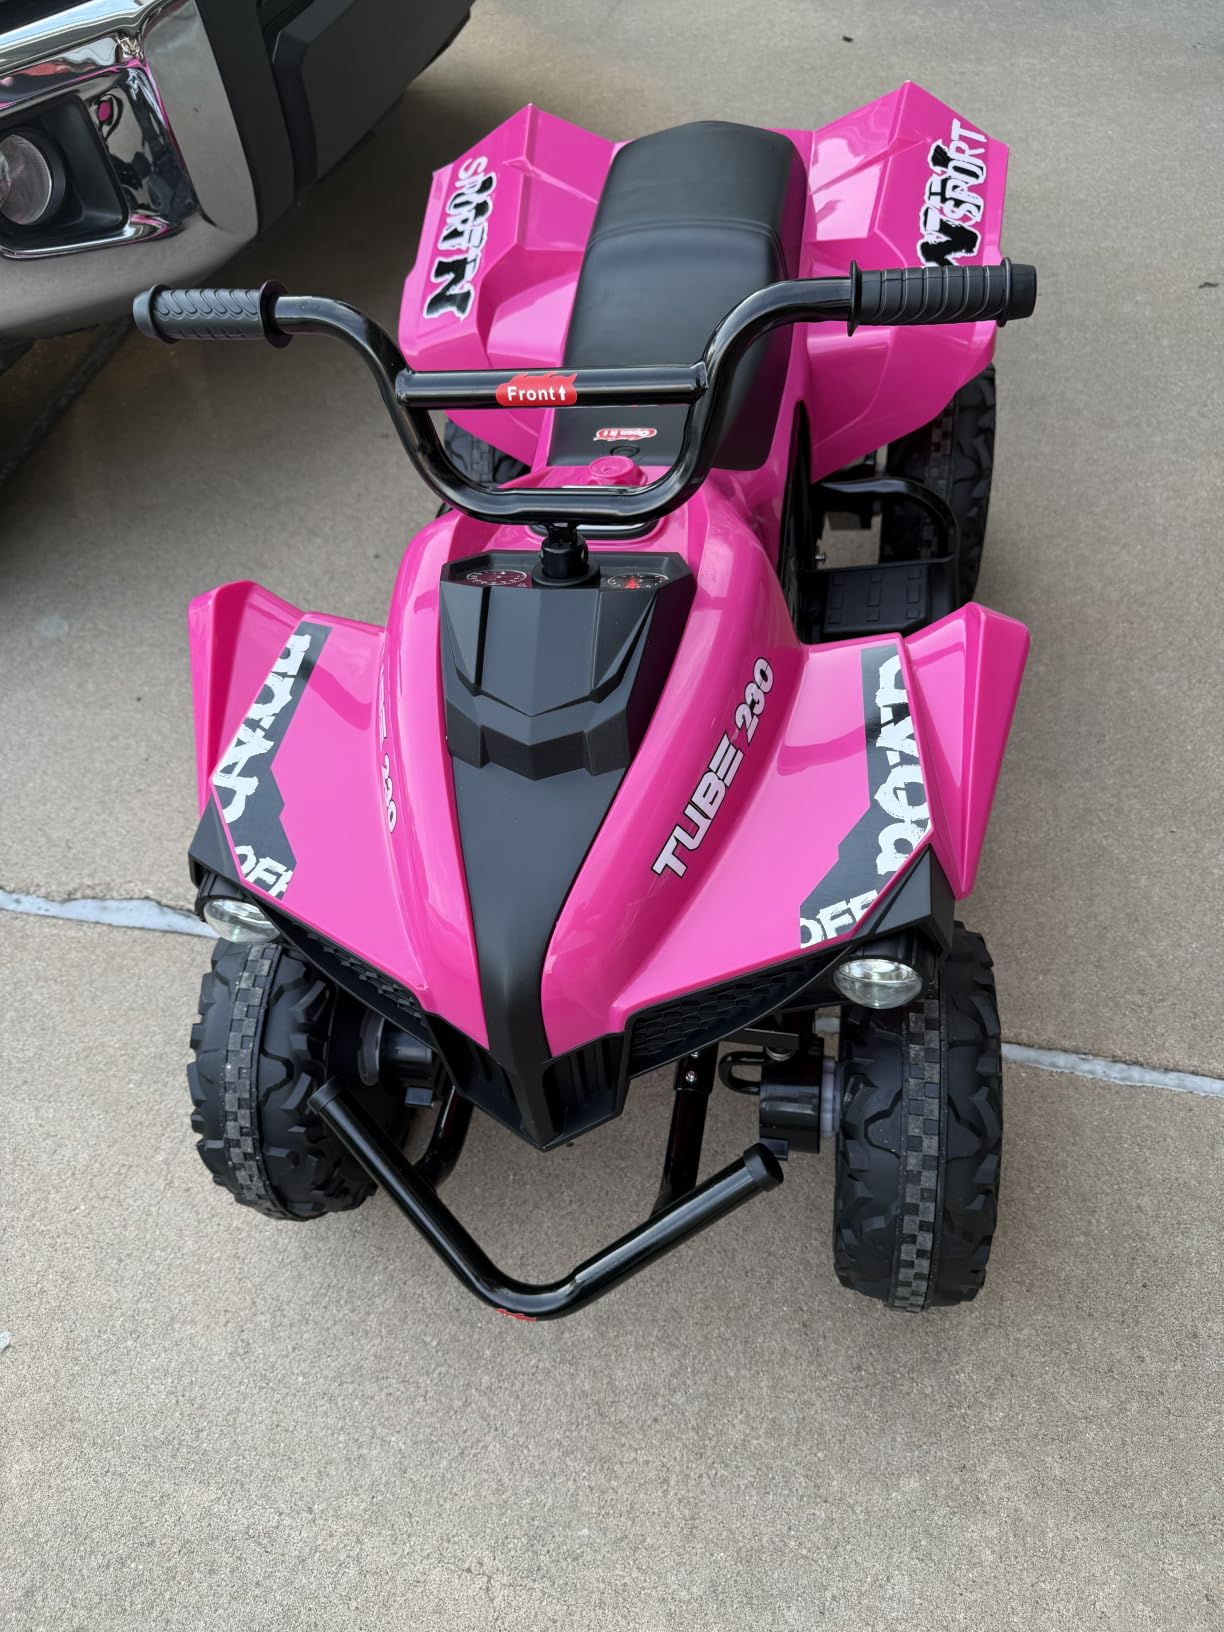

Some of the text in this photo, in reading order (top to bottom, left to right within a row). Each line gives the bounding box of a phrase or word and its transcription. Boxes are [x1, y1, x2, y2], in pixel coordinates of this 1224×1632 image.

[943, 118, 987, 222] SPORT
[507, 386, 556, 401] Front
[651, 657, 774, 878] TUBE 230
